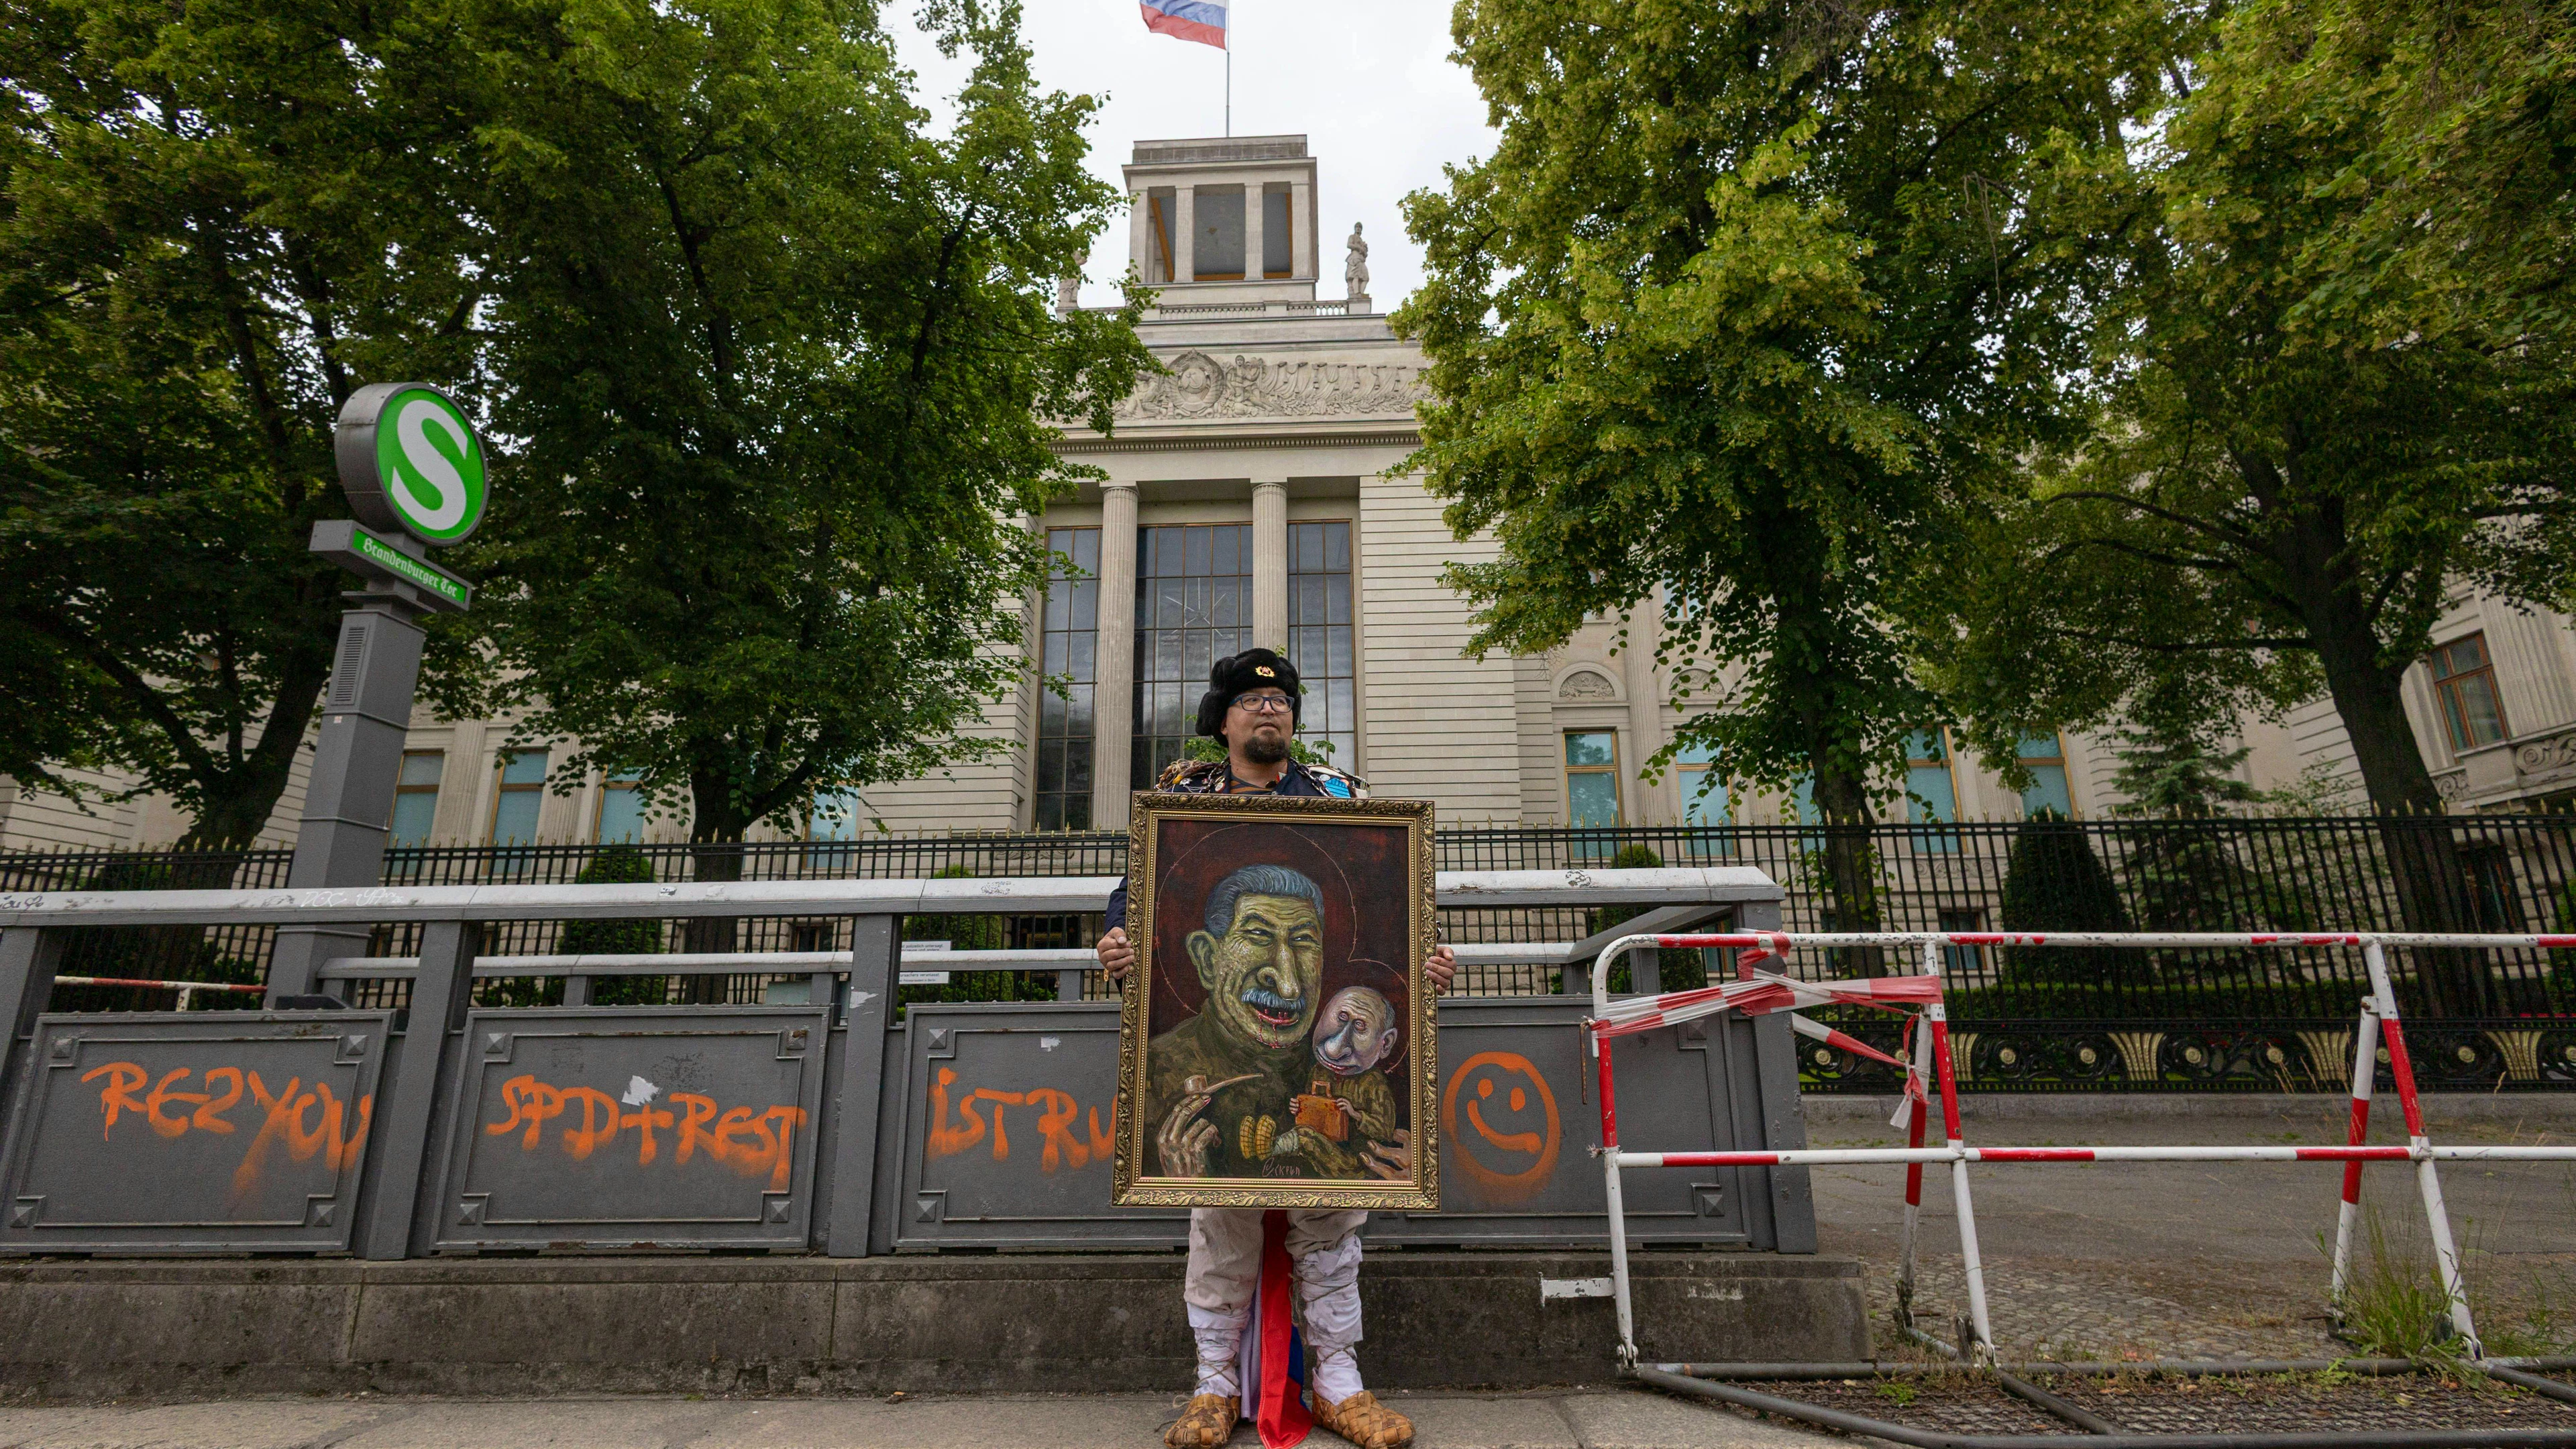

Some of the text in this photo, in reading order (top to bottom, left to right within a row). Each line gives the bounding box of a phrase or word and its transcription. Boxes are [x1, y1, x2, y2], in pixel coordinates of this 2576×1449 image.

[391, 400, 468, 531] S
[363, 537, 458, 597] Brandenburger Tor
